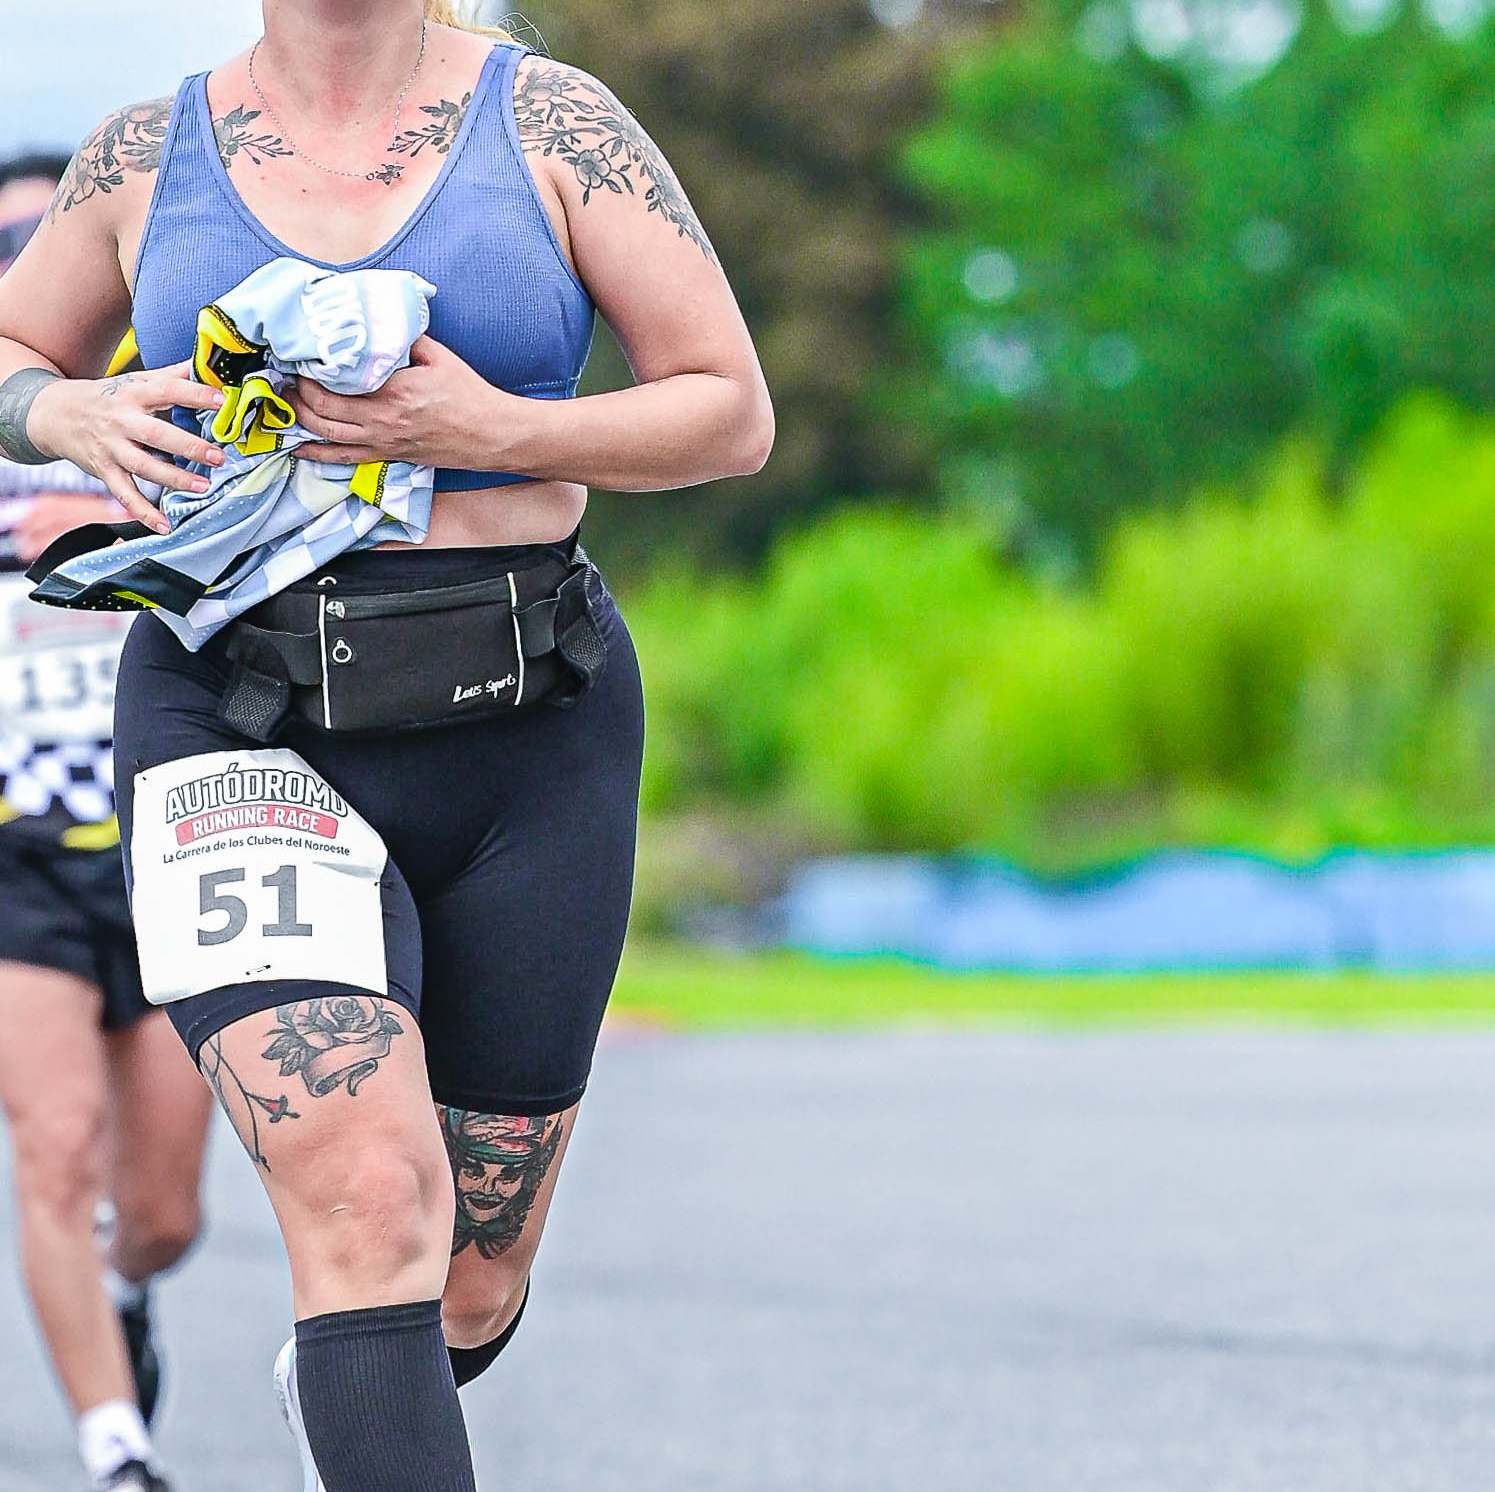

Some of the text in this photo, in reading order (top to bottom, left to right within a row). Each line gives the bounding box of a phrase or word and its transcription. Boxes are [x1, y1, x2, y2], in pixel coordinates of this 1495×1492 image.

[192, 807, 320, 839] RUNNING RACE
[163, 835, 351, 864] La Carrera de los Clubes del Noroeste
[198, 865, 312, 945] 51
